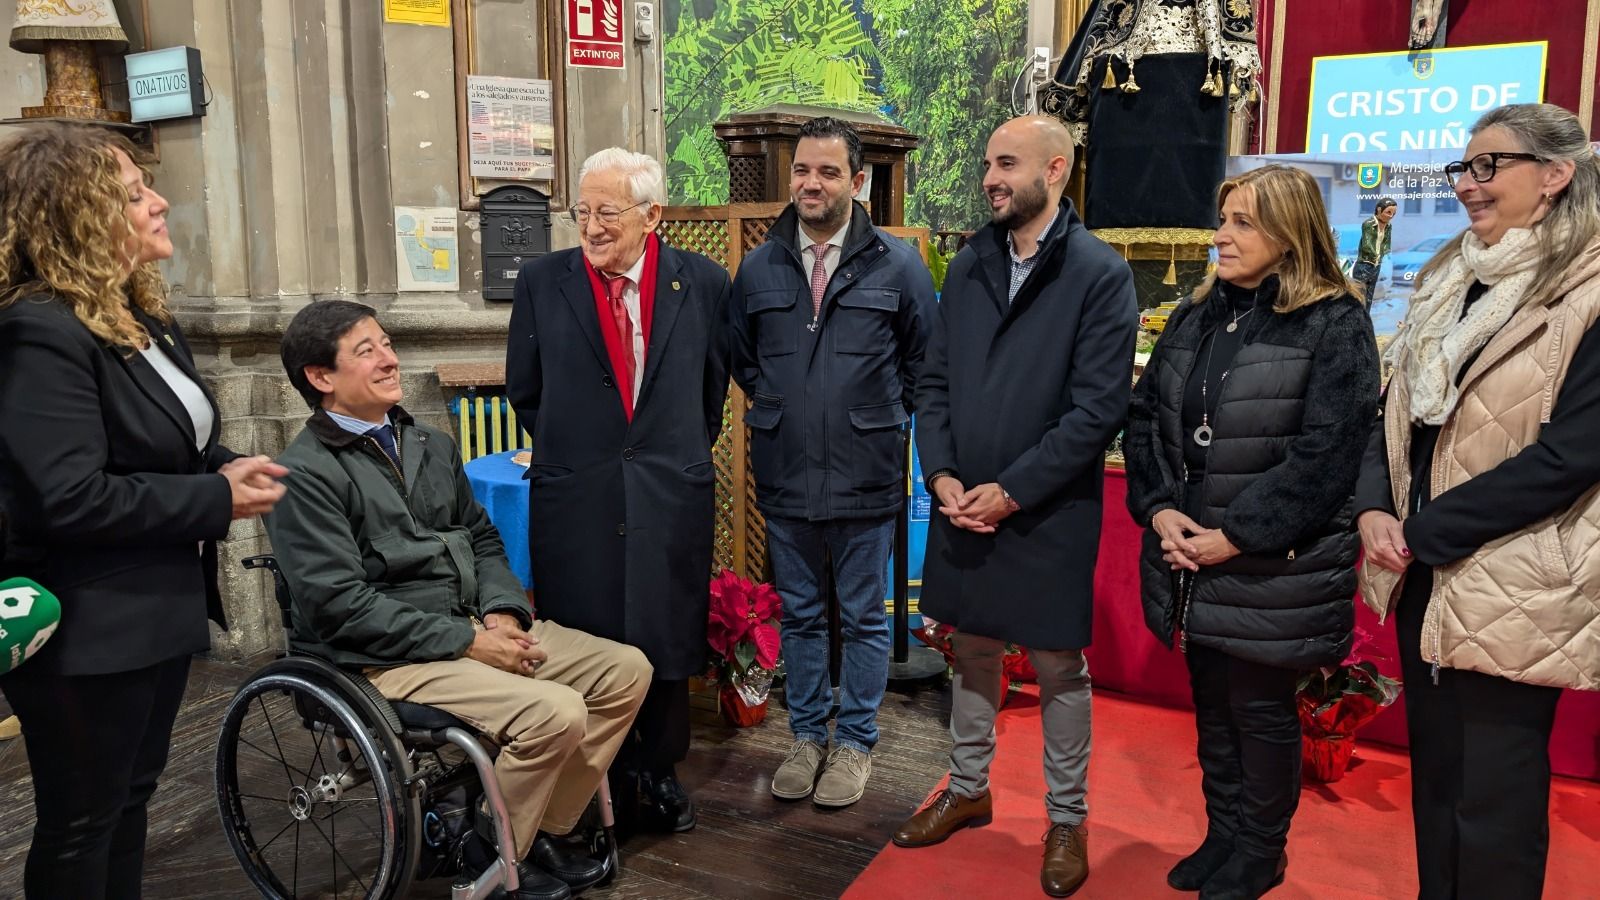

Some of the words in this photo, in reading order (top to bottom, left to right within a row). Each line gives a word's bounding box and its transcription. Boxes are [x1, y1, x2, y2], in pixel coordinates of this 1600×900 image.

[573, 48, 620, 60] EXTINTOR
[135, 73, 187, 96] ONATIVOS
[1327, 85, 1459, 118] CRISTO
[1470, 82, 1521, 112] DE
[1321, 131, 1388, 154] LOS
[1400, 121, 1472, 151] NIÑ
[1390, 160, 1446, 175] Mensajer
[1388, 176, 1404, 188] de
[1407, 176, 1418, 188] la
[1421, 175, 1442, 188] Paz
[1356, 190, 1459, 201] www.mensajerosdela
